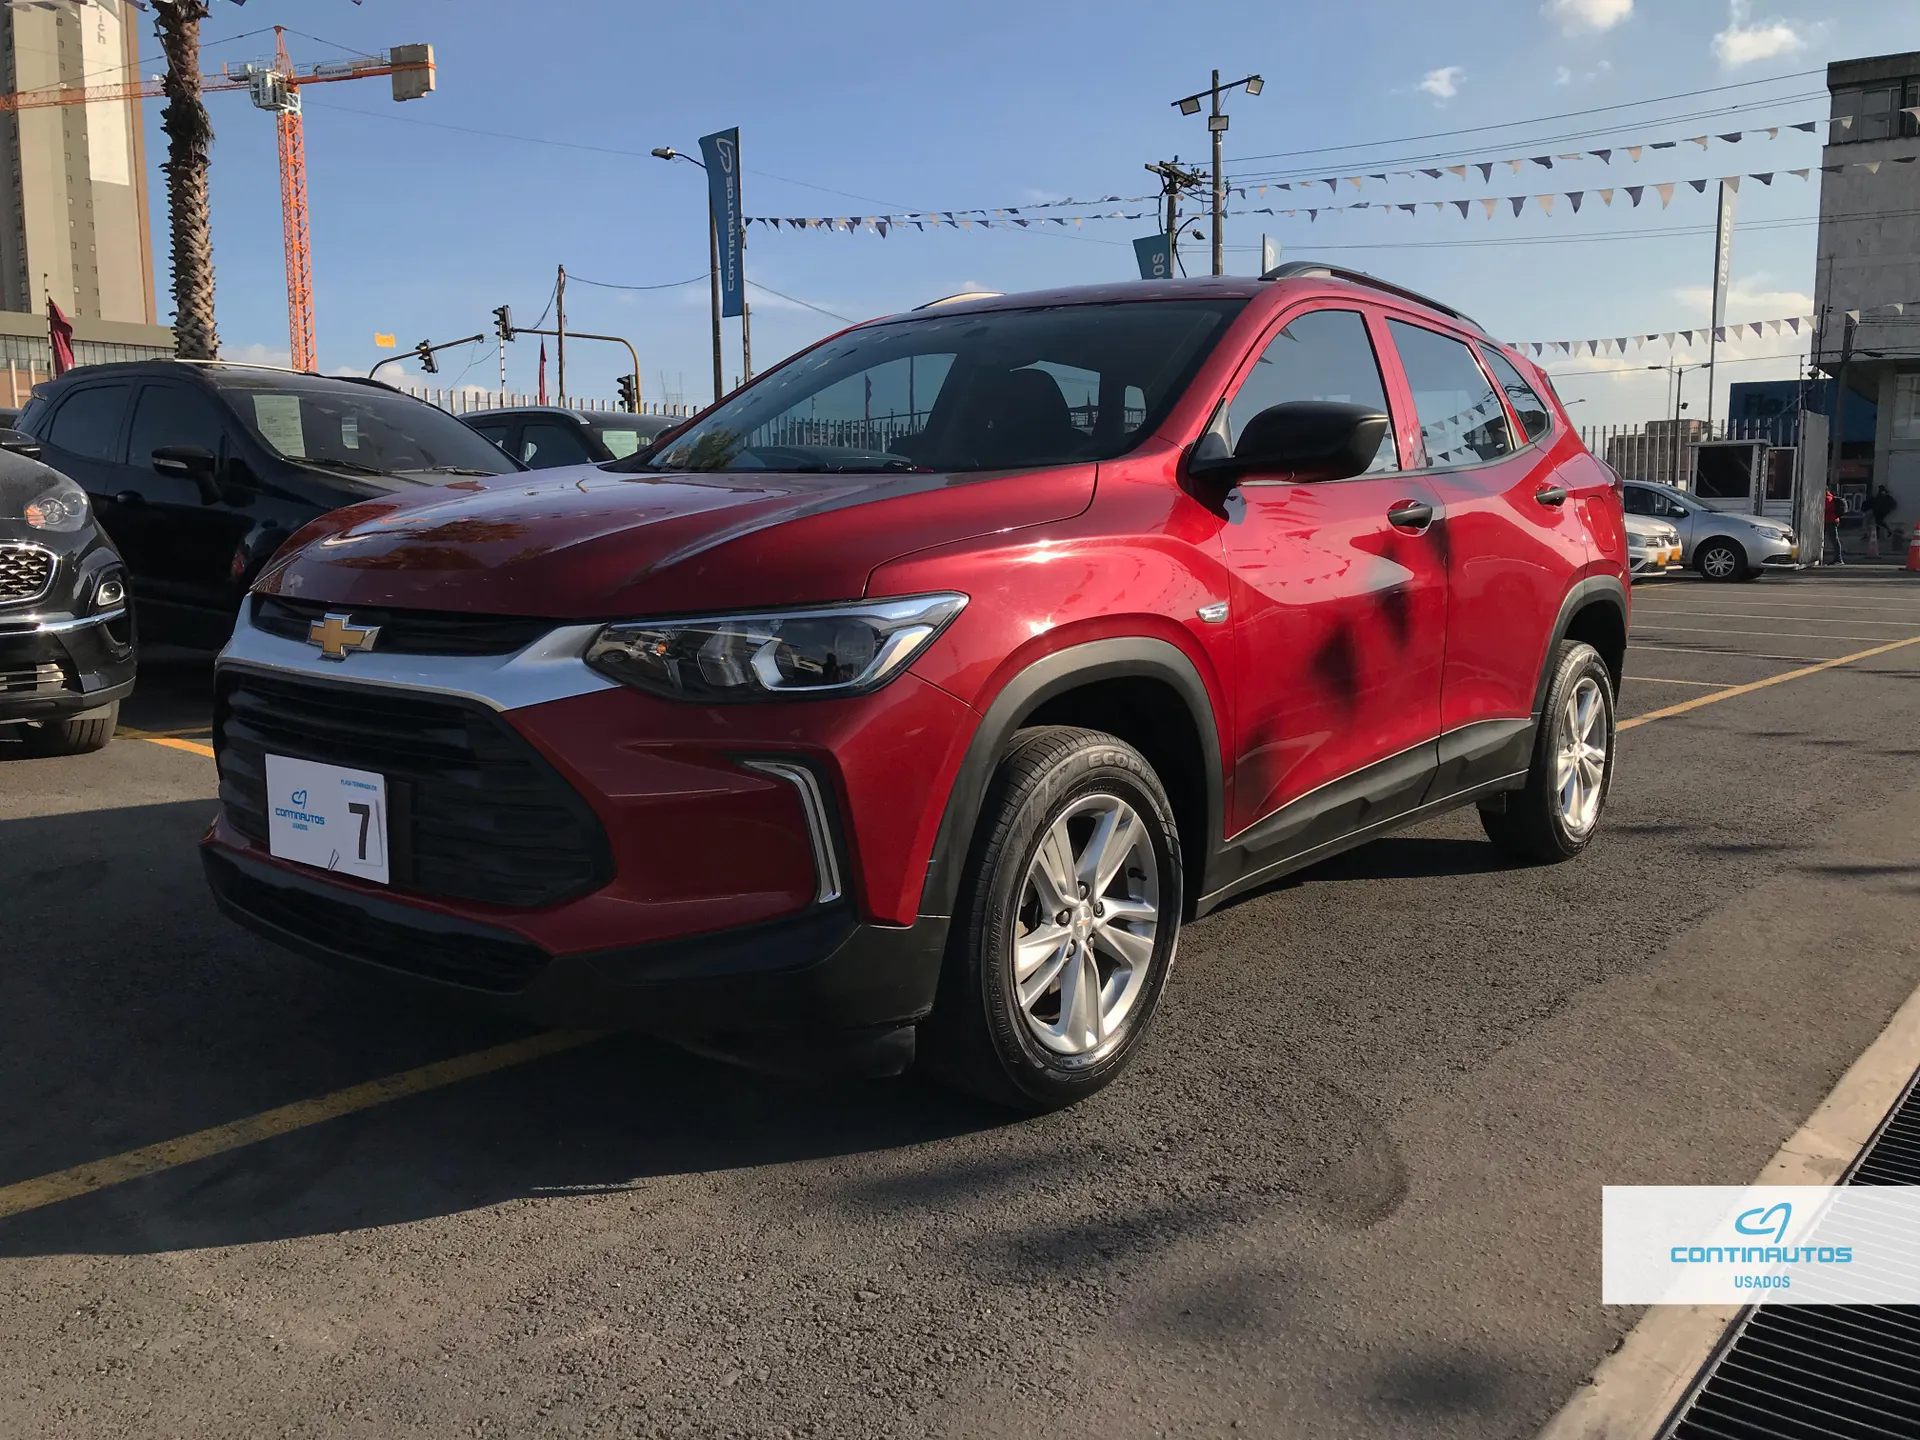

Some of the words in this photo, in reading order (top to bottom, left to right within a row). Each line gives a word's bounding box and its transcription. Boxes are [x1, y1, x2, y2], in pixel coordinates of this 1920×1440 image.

[726, 176, 736, 292] CONTINAUTOS
[1720, 204, 1732, 286] USADOS
[1152, 252, 1165, 279] OS
[275, 807, 325, 825] CONTINAUTOS
[348, 802, 370, 860] 7
